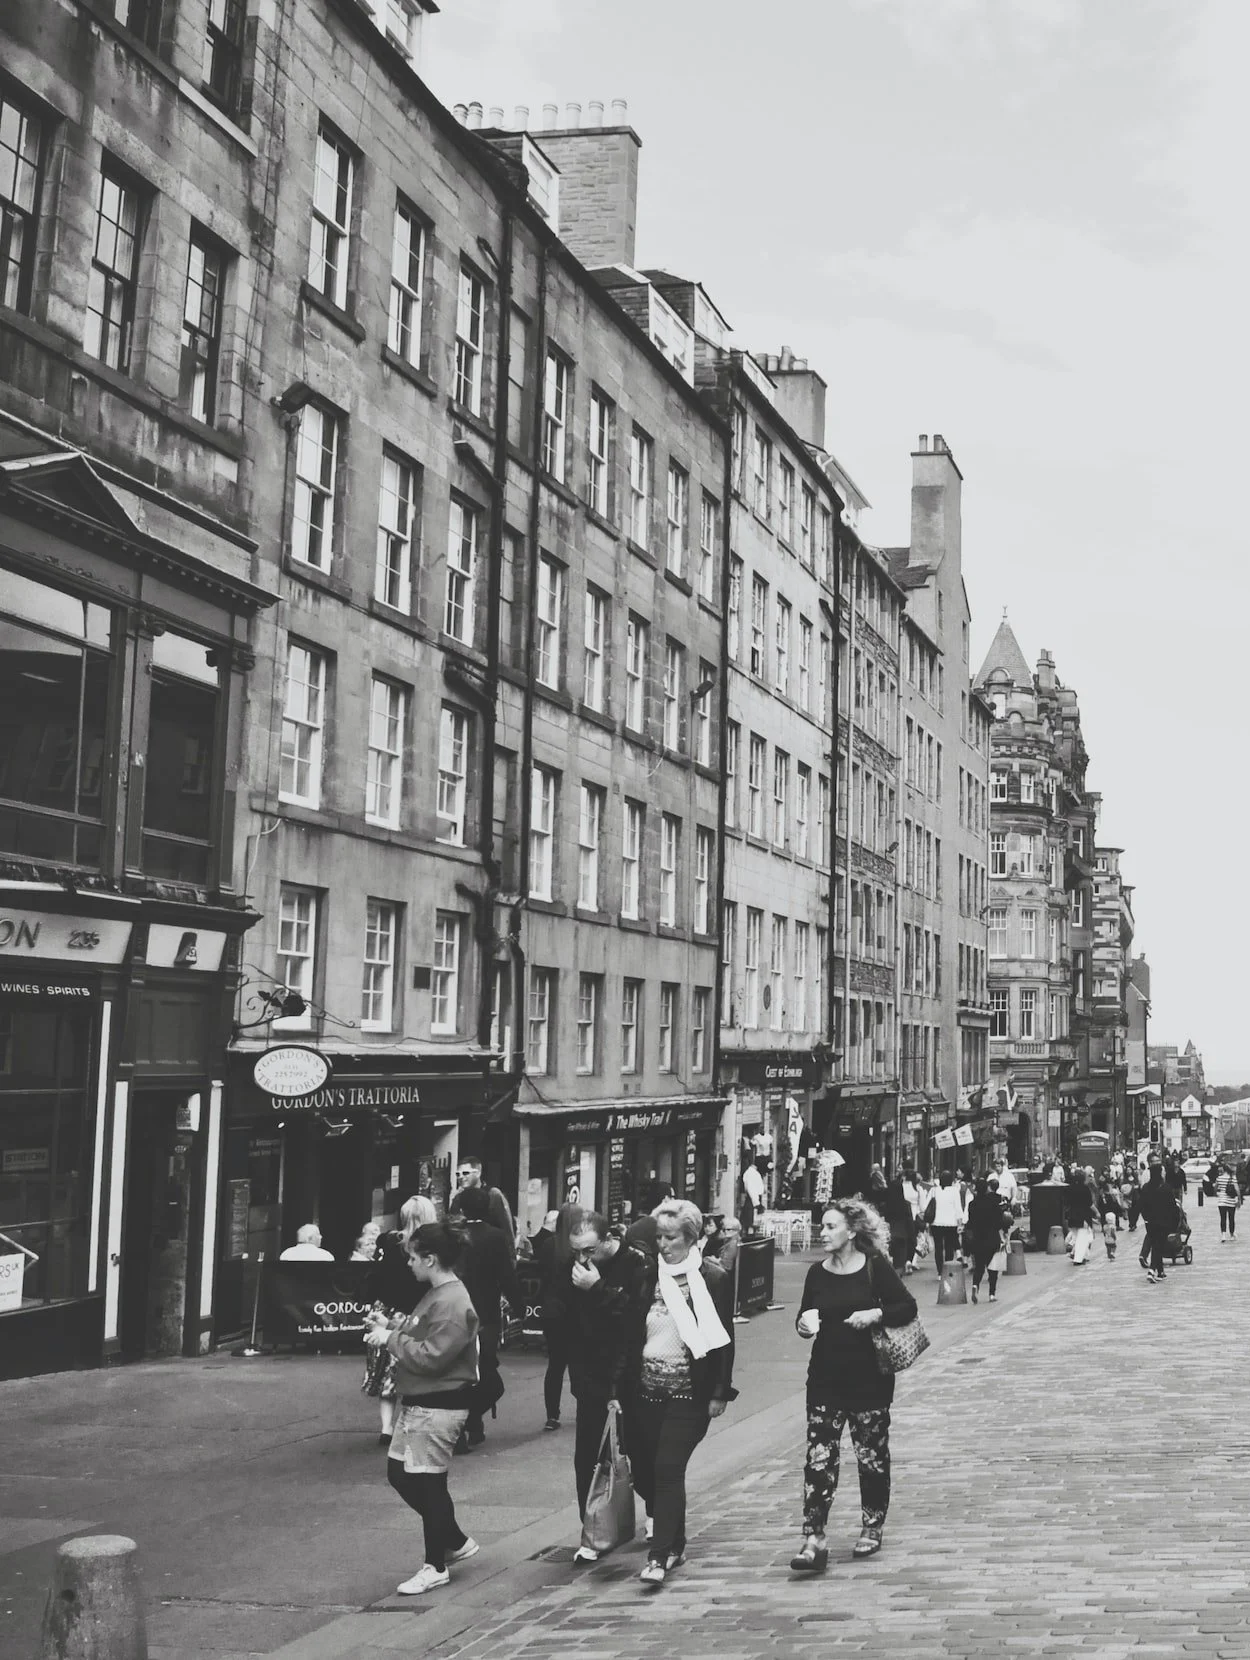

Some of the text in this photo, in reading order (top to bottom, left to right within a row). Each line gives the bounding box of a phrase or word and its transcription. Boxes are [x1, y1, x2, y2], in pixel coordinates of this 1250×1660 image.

[1, 983, 91, 996] WINES SPIRITS
[261, 1050, 321, 1068] GORDON'S
[258, 1073, 324, 1094] TRATTORIA
[349, 1086, 420, 1106] TRATTORIA
[616, 1114, 628, 1129] The
[628, 1112, 651, 1131] Whisky
[650, 1111, 666, 1126] Trail
